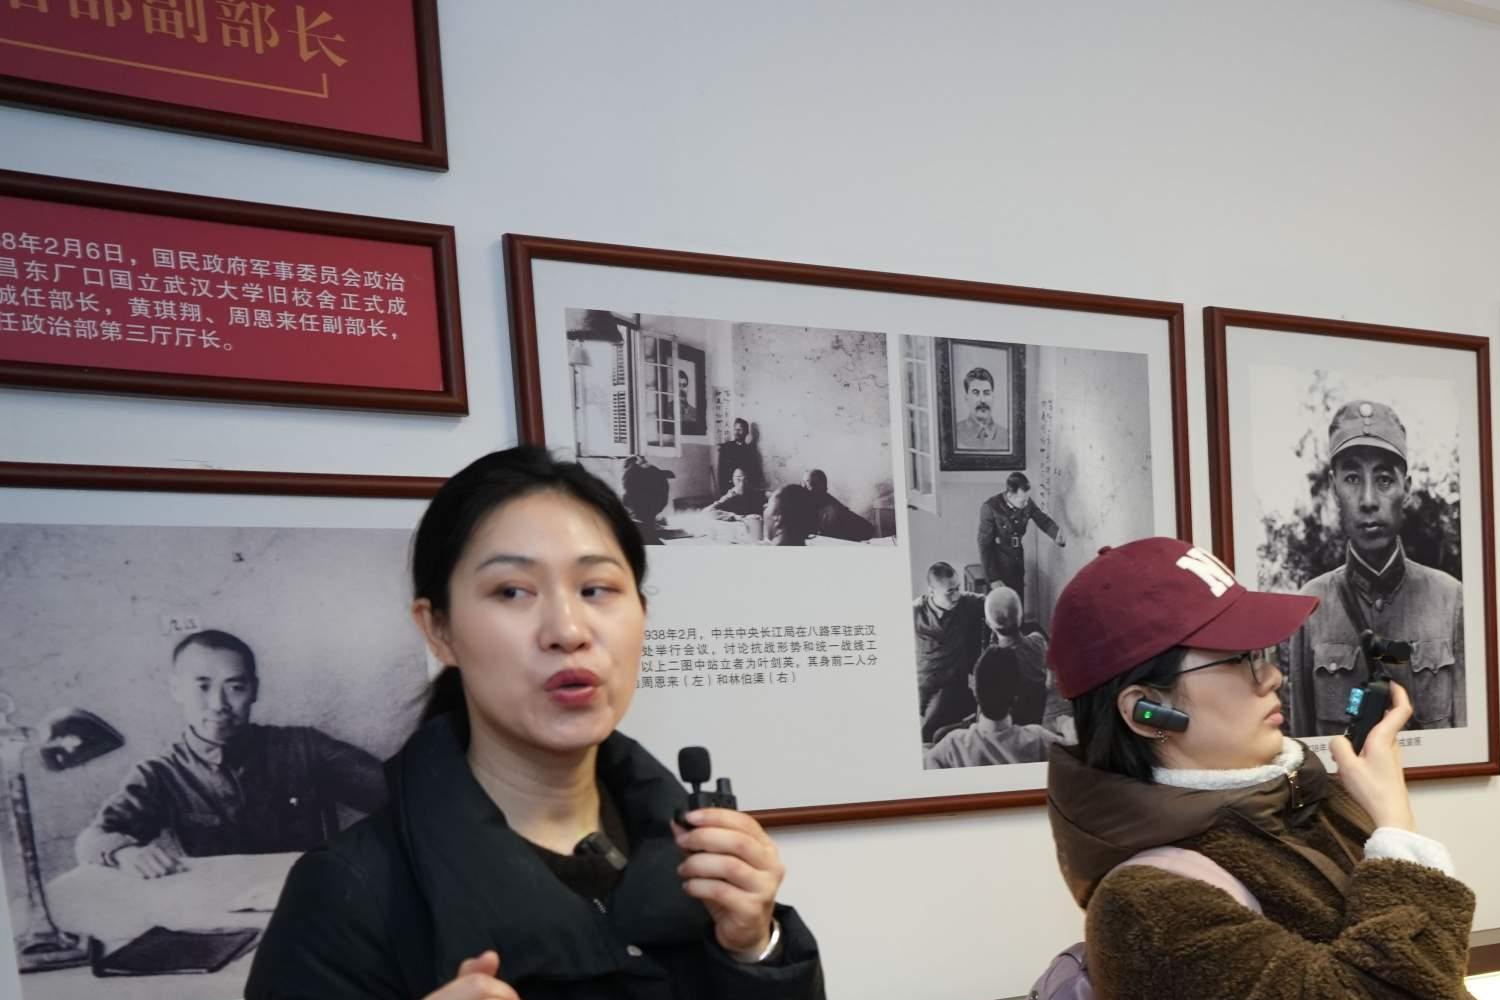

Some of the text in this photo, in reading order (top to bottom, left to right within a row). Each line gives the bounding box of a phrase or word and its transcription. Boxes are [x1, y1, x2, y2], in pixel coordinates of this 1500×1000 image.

[637, 671, 797, 689] 周恩来（左）和林伯渠（右）
